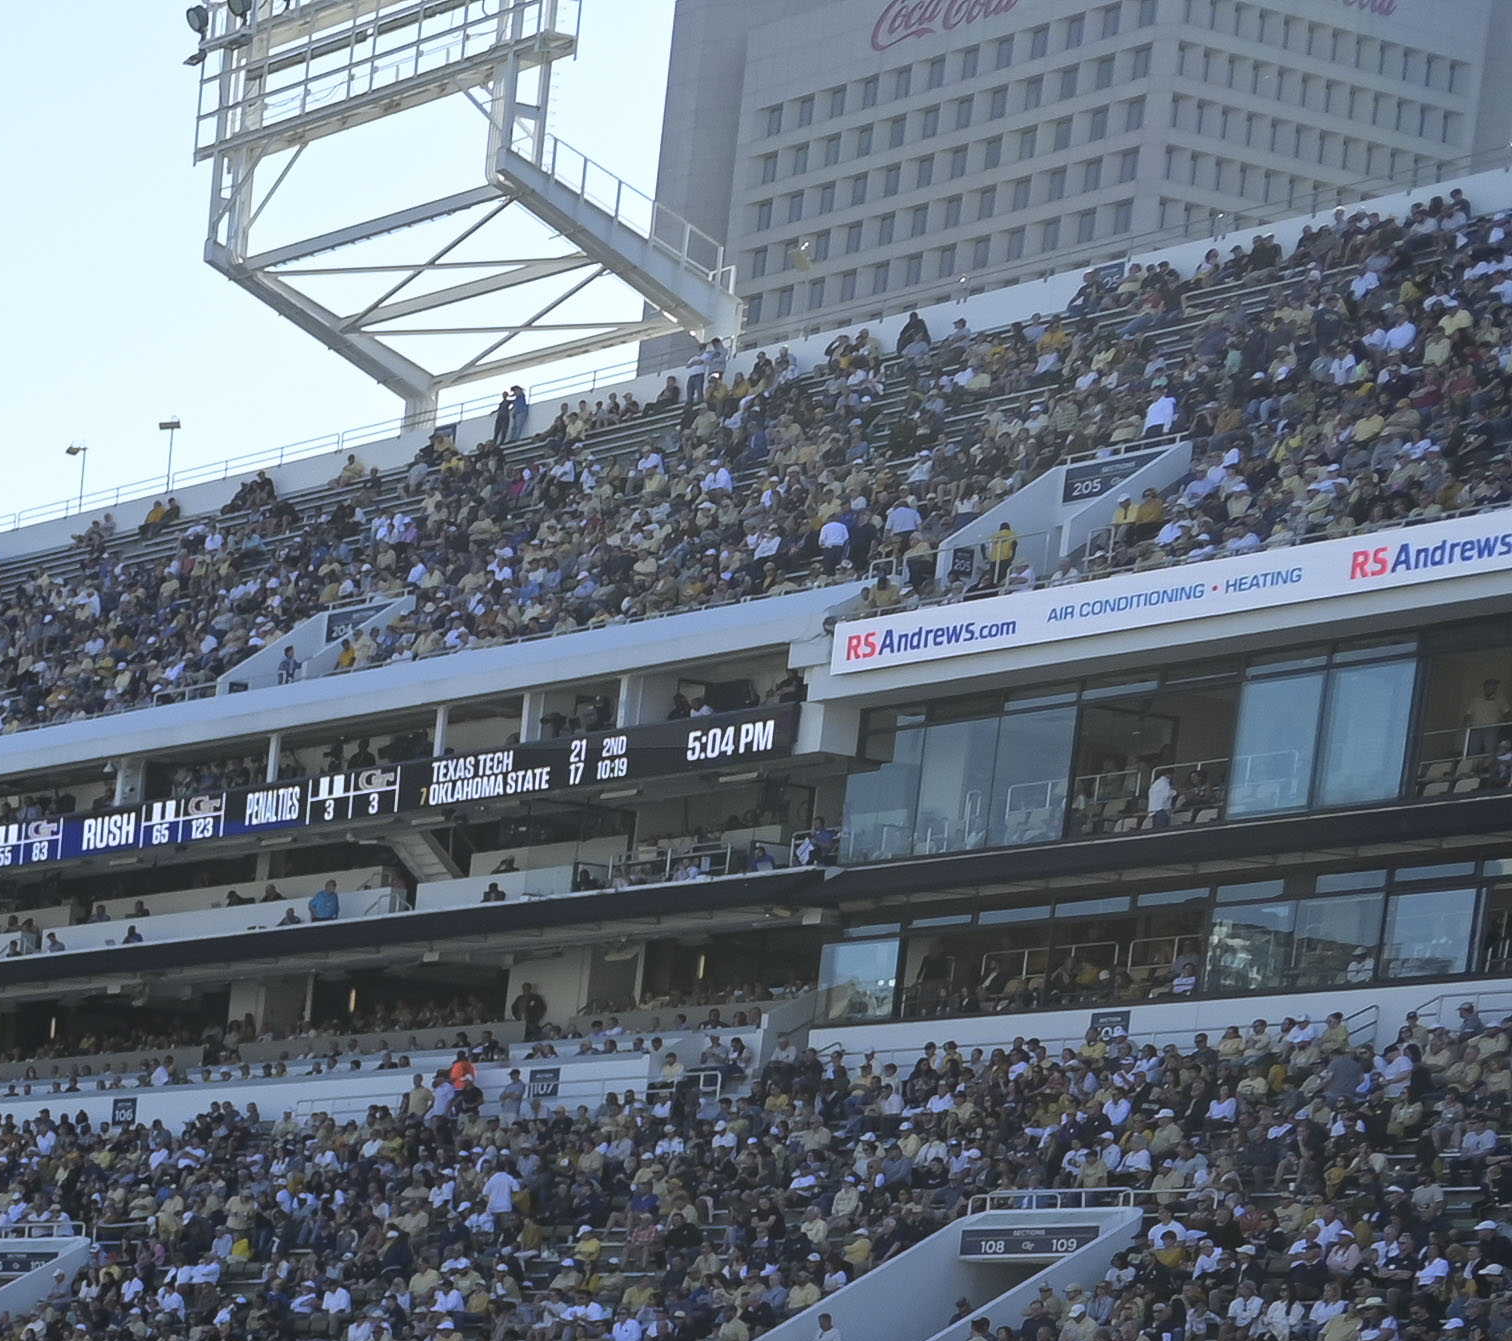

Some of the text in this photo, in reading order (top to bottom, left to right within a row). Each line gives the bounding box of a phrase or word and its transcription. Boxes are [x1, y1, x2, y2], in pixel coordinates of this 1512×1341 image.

[1072, 479, 1101, 496] 205
[1047, 567, 1302, 623] AIR CONDITIONING HEATING
[570, 736, 627, 762] 21 2ND
[687, 719, 776, 762] 5:04 PM
[432, 750, 514, 784] TEXAS TECH
[569, 757, 627, 784] 17 10:19
[429, 772, 504, 806] OKLAHOMA
[506, 767, 550, 794] STATE
[245, 786, 300, 826] PENALTIES
[324, 801, 334, 820] 3
[368, 791, 378, 815] 3
[82, 811, 136, 852] RUSH
[152, 825, 169, 845] 65
[191, 818, 213, 839] 123
[32, 841, 48, 861] 83
[980, 1237, 1077, 1254] 108 109
